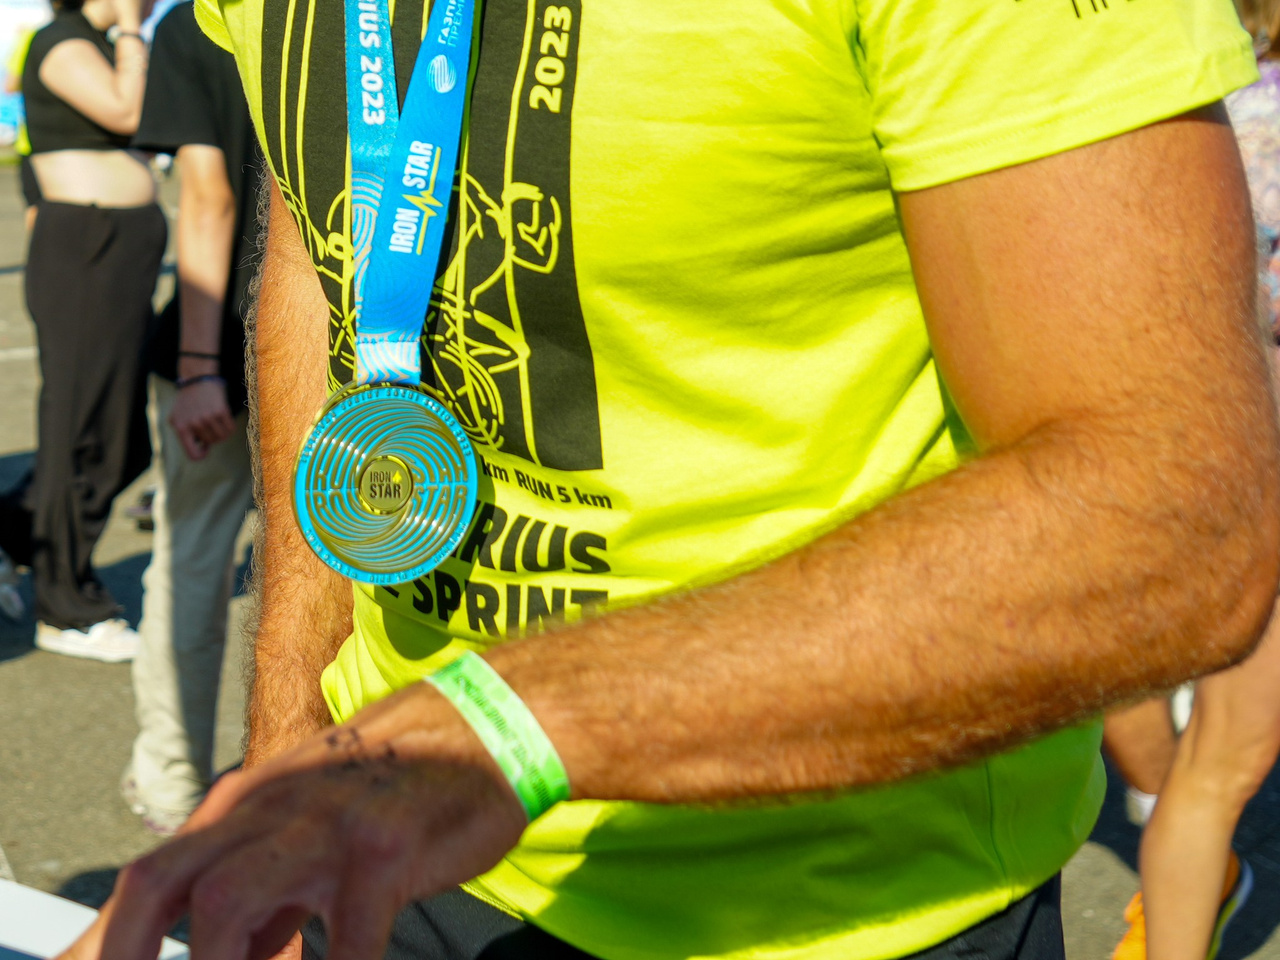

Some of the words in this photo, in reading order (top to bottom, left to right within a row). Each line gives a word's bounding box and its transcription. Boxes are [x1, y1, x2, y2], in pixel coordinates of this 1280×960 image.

[529, 4, 572, 113] 2023
[360, 55, 386, 126] 2023
[402, 140, 434, 189] STAR
[388, 207, 420, 254] IRON
[370, 471, 391, 483] IRON
[370, 483, 401, 499] STAR
[481, 455, 510, 483] km
[514, 468, 555, 503] RUN
[555, 486, 571, 503] 5
[573, 487, 613, 510] km
[455, 500, 611, 574] RIUS
